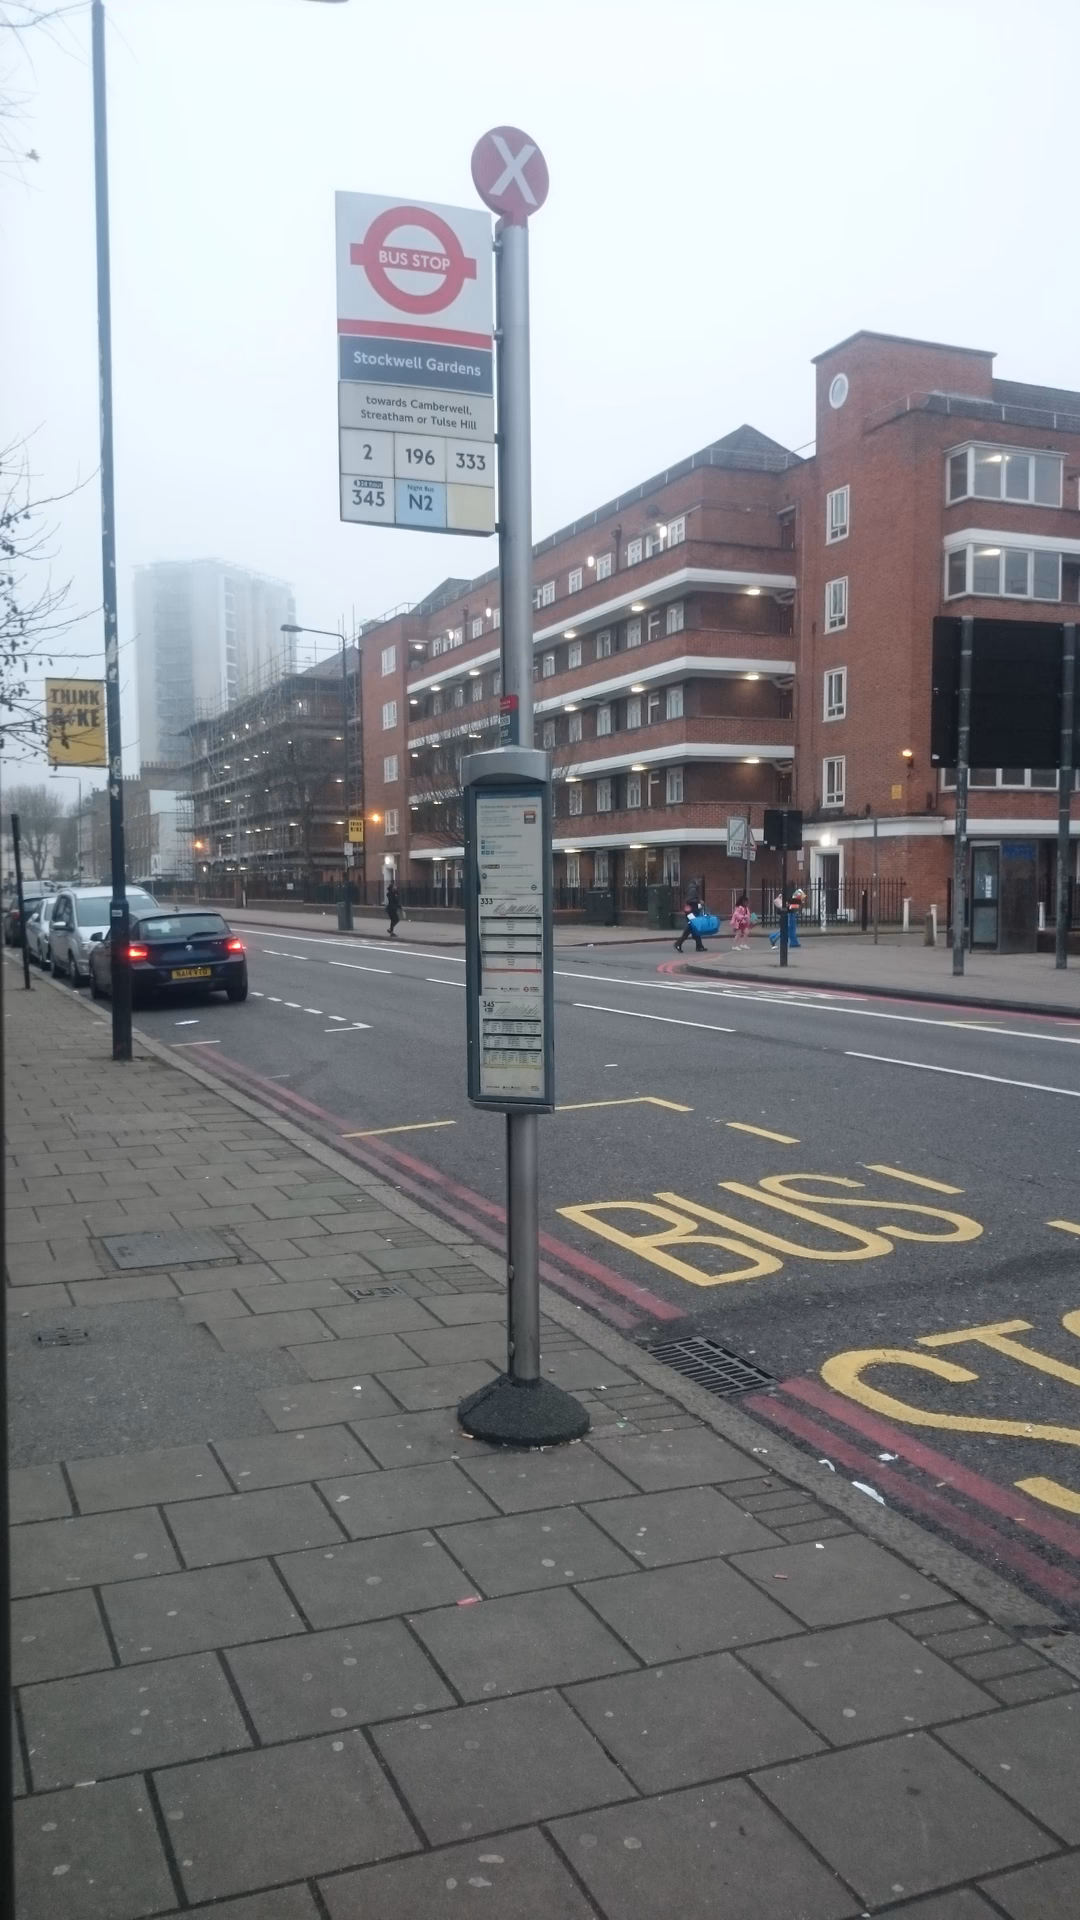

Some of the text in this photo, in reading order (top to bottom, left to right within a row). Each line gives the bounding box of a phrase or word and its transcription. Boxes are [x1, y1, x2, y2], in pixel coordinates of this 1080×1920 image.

[488, 134, 538, 206] X
[378, 250, 450, 271] BUS STOP
[353, 351, 481, 377] Stockwell Gardens
[366, 395, 472, 416] towards Camberwell,
[361, 409, 477, 431] Streatham or Tulse Hill
[362, 444, 373, 460] 2
[405, 448, 435, 466] 196
[455, 452, 486, 471] 333
[407, 484, 423, 492] Night
[352, 489, 385, 507] 345
[409, 493, 433, 511] N2
[50, 688, 100, 706] THINK
[480, 897, 494, 905] 333
[555, 1172, 985, 1287] BUS
